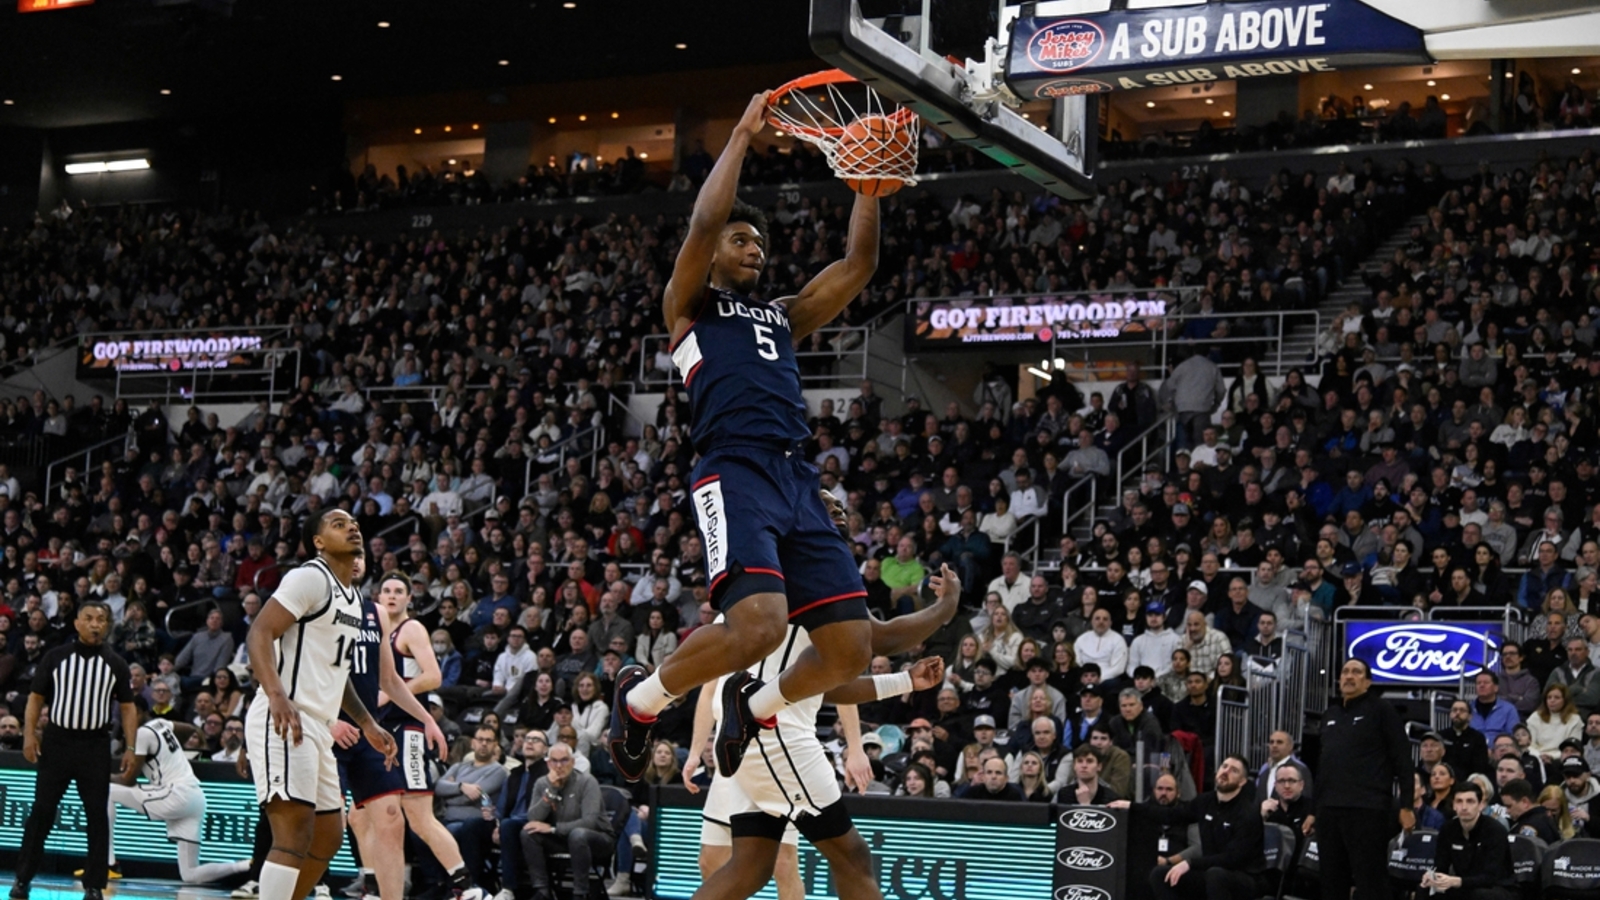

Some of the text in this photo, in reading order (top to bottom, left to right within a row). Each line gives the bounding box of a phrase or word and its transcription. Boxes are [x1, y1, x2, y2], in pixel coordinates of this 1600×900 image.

[1038, 30, 1096, 46] Jersey
[1108, 4, 1327, 60] A SUB ABOVE
[1052, 60, 1074, 68] SUBS
[1118, 58, 1336, 90] A SUB ABOVE
[412, 215, 433, 228] 229
[930, 307, 981, 329] GOT
[94, 341, 129, 360] GOT
[753, 323, 779, 361] 5
[701, 490, 719, 573] HUSKIES
[330, 634, 356, 669] 14
[354, 646, 368, 674] 11
[1376, 631, 1470, 672] Ford
[410, 734, 421, 786] HUSKIES
[1069, 811, 1108, 829] Ford
[1066, 849, 1105, 867] Ford
